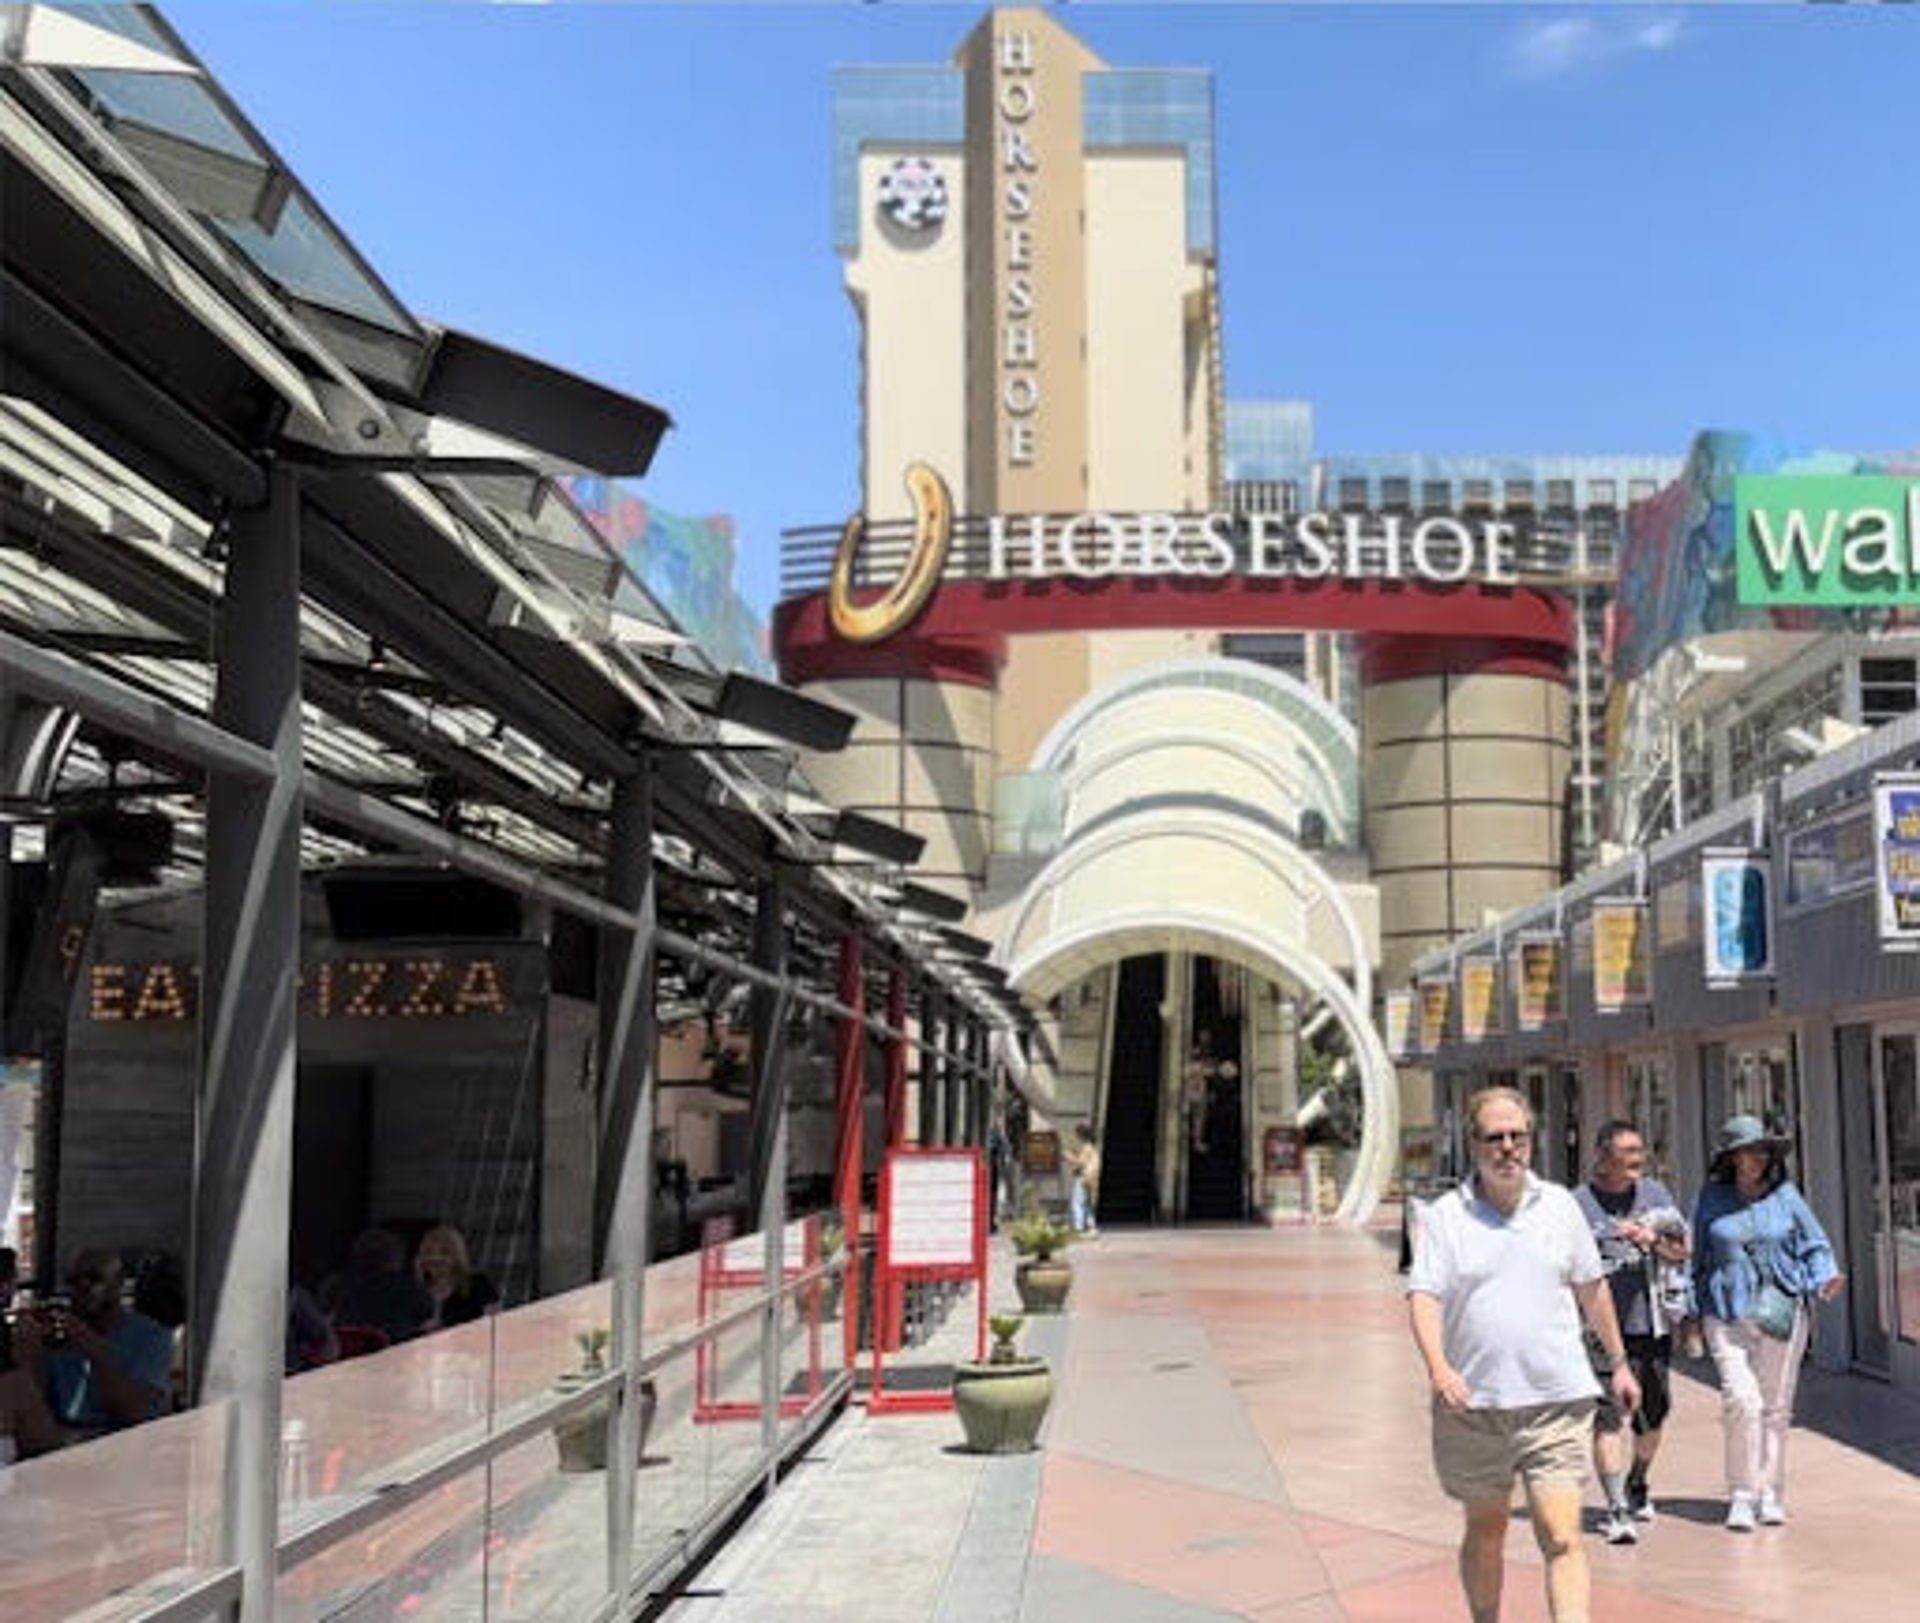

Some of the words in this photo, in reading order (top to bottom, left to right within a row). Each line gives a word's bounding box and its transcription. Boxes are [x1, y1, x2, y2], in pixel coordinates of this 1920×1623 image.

[1000, 30, 1038, 468] HORSESHOE
[986, 511, 1520, 583] HORSESHOE
[90, 963, 201, 1020] EA
[294, 961, 504, 1016] IZZA
